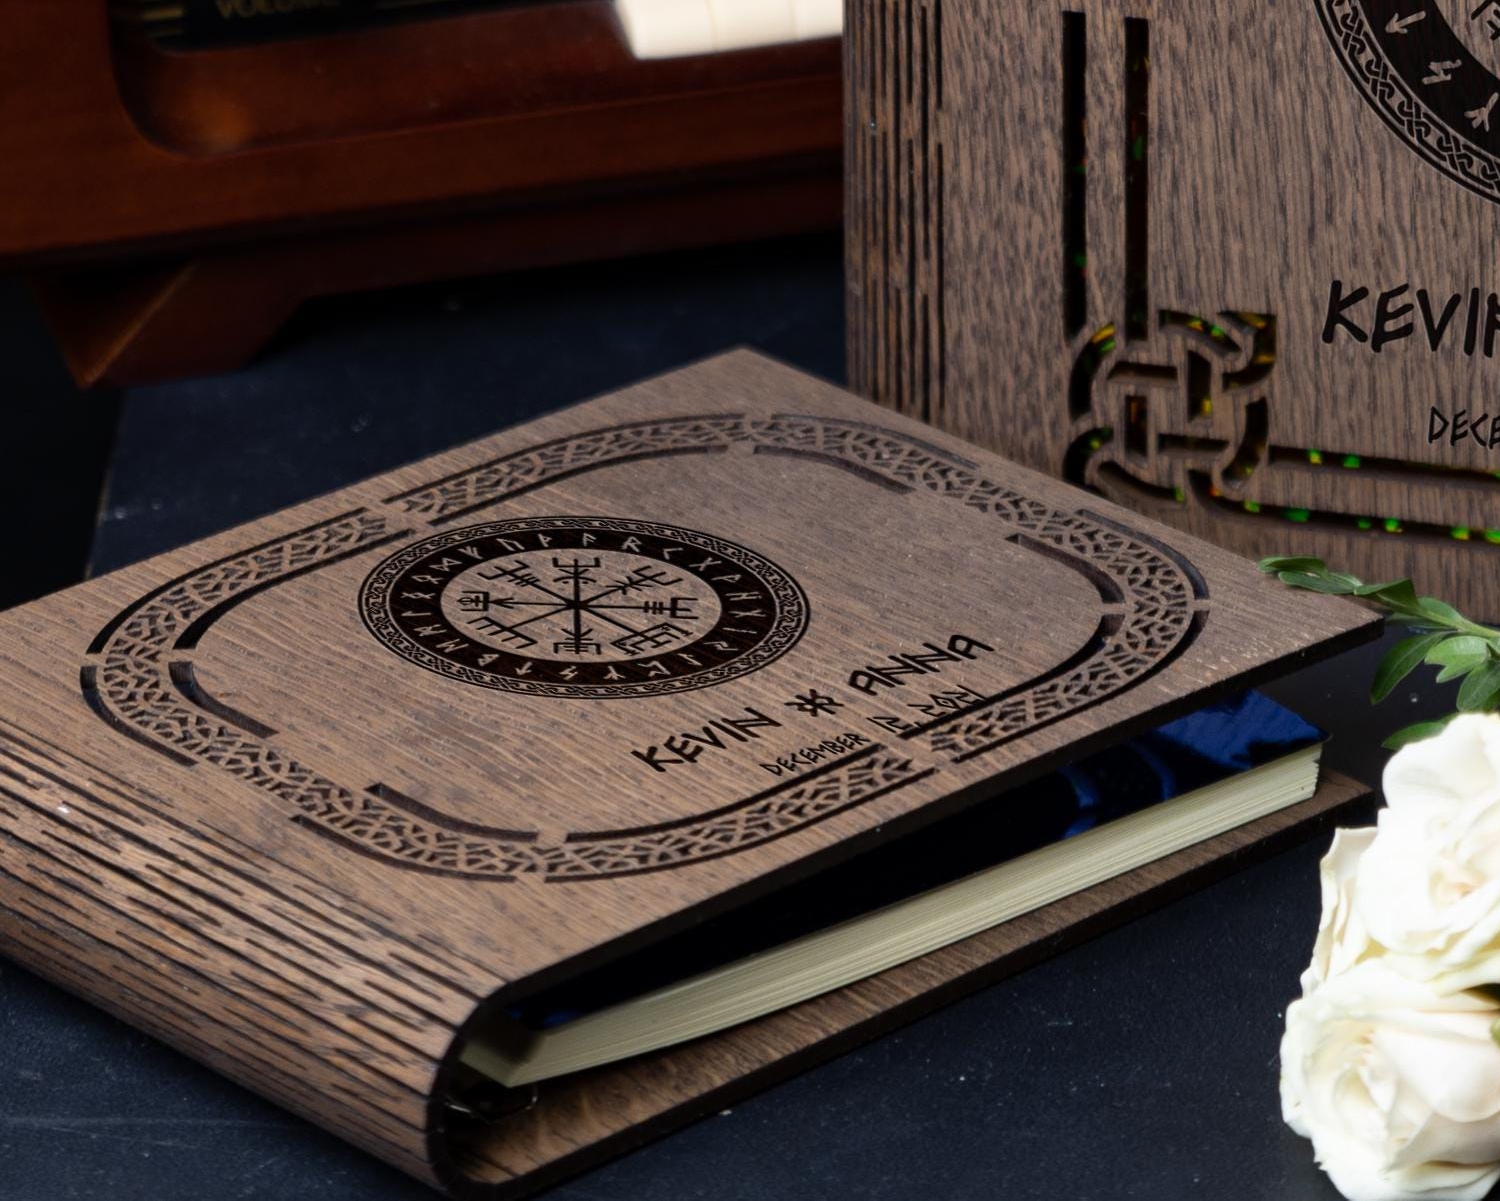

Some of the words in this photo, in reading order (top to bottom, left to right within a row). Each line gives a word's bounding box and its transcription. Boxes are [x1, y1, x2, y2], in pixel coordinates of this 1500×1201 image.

[631, 707, 782, 772] KEVIN
[848, 634, 995, 696] ANNA
[759, 732, 871, 777] DECEMBER
